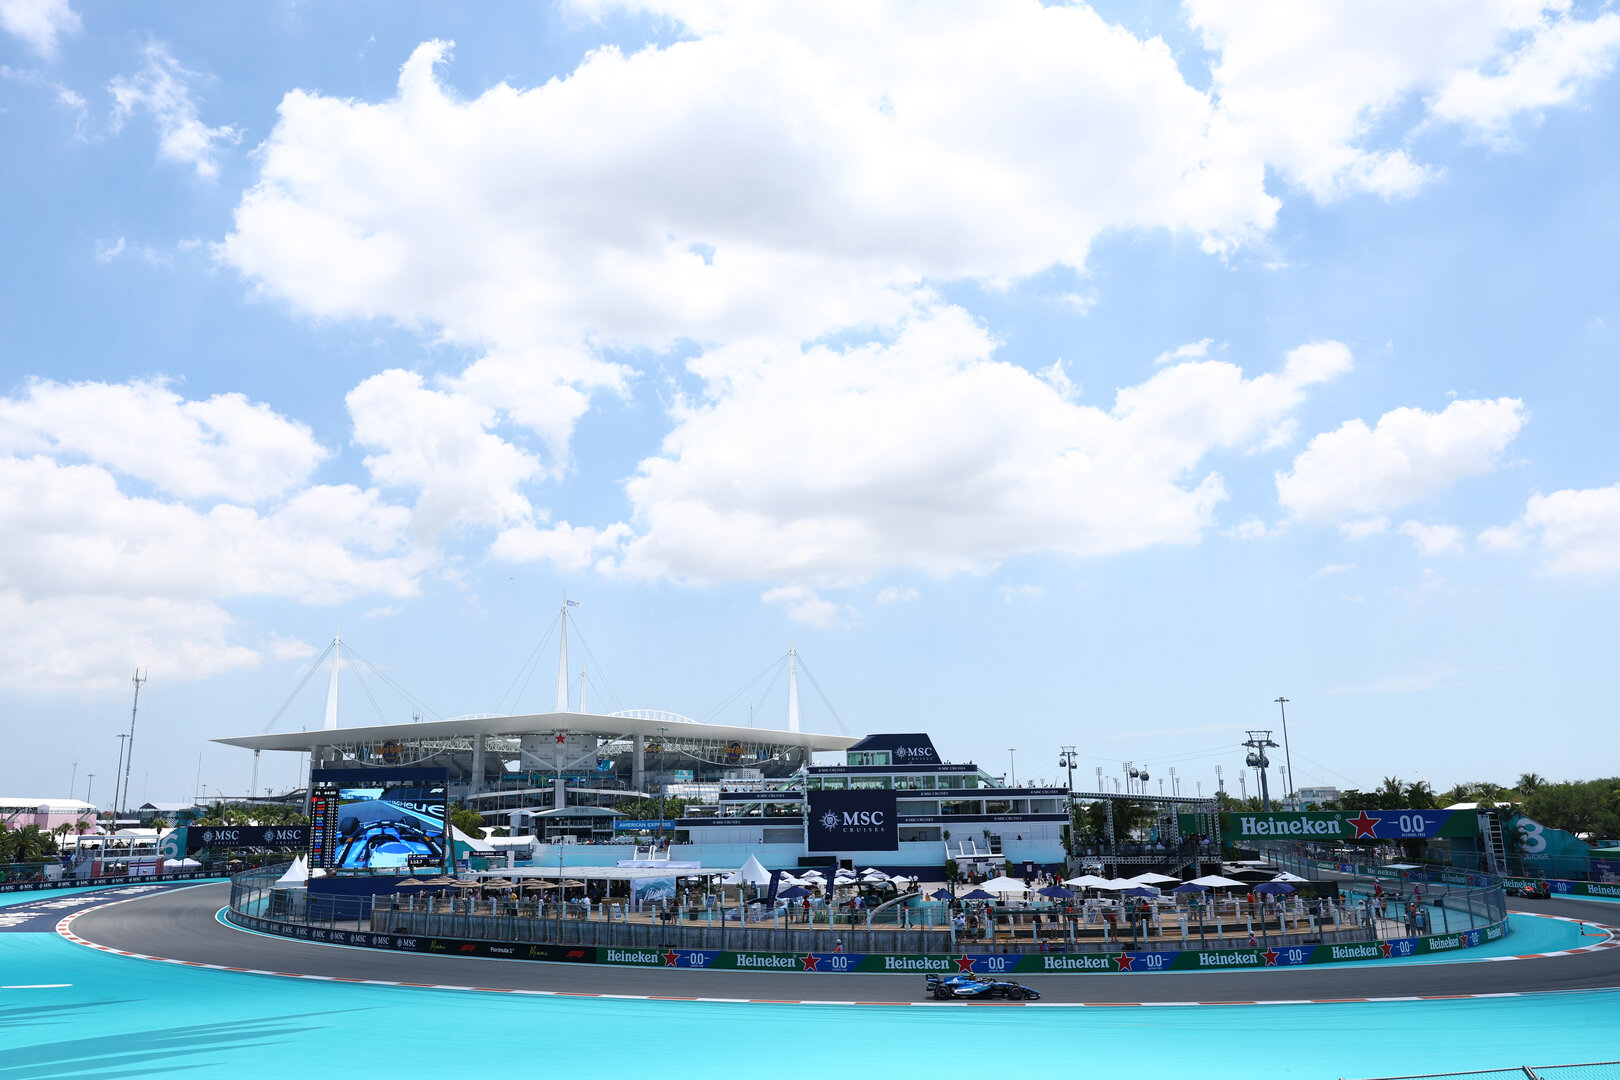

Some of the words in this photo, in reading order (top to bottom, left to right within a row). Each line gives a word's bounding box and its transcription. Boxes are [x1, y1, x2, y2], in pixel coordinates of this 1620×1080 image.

[908, 747, 932, 756] MSC
[843, 811, 883, 825] MSC
[1240, 817, 1341, 835] Heineken
[1400, 815, 1424, 832] 0.0
[215, 830, 239, 840] MSC
[276, 830, 301, 840] MSC
[1517, 818, 1546, 853] 3
[161, 834, 178, 859] 6
[403, 939, 416, 947] MSC
[1332, 945, 1377, 958] Heineken
[1400, 942, 1409, 952] 0.0
[1429, 938, 1459, 950] Heineken
[607, 950, 658, 963] Heineken
[690, 953, 703, 964] 0.0
[737, 954, 796, 967] Heineken
[832, 957, 847, 968] 0.0
[885, 956, 950, 969] Heineken
[988, 958, 1004, 969] 0.0
[1044, 957, 1109, 969] Heineken
[1147, 955, 1162, 967] 0.0
[1199, 952, 1257, 965] Heineken
[1289, 949, 1302, 961] 0.0
